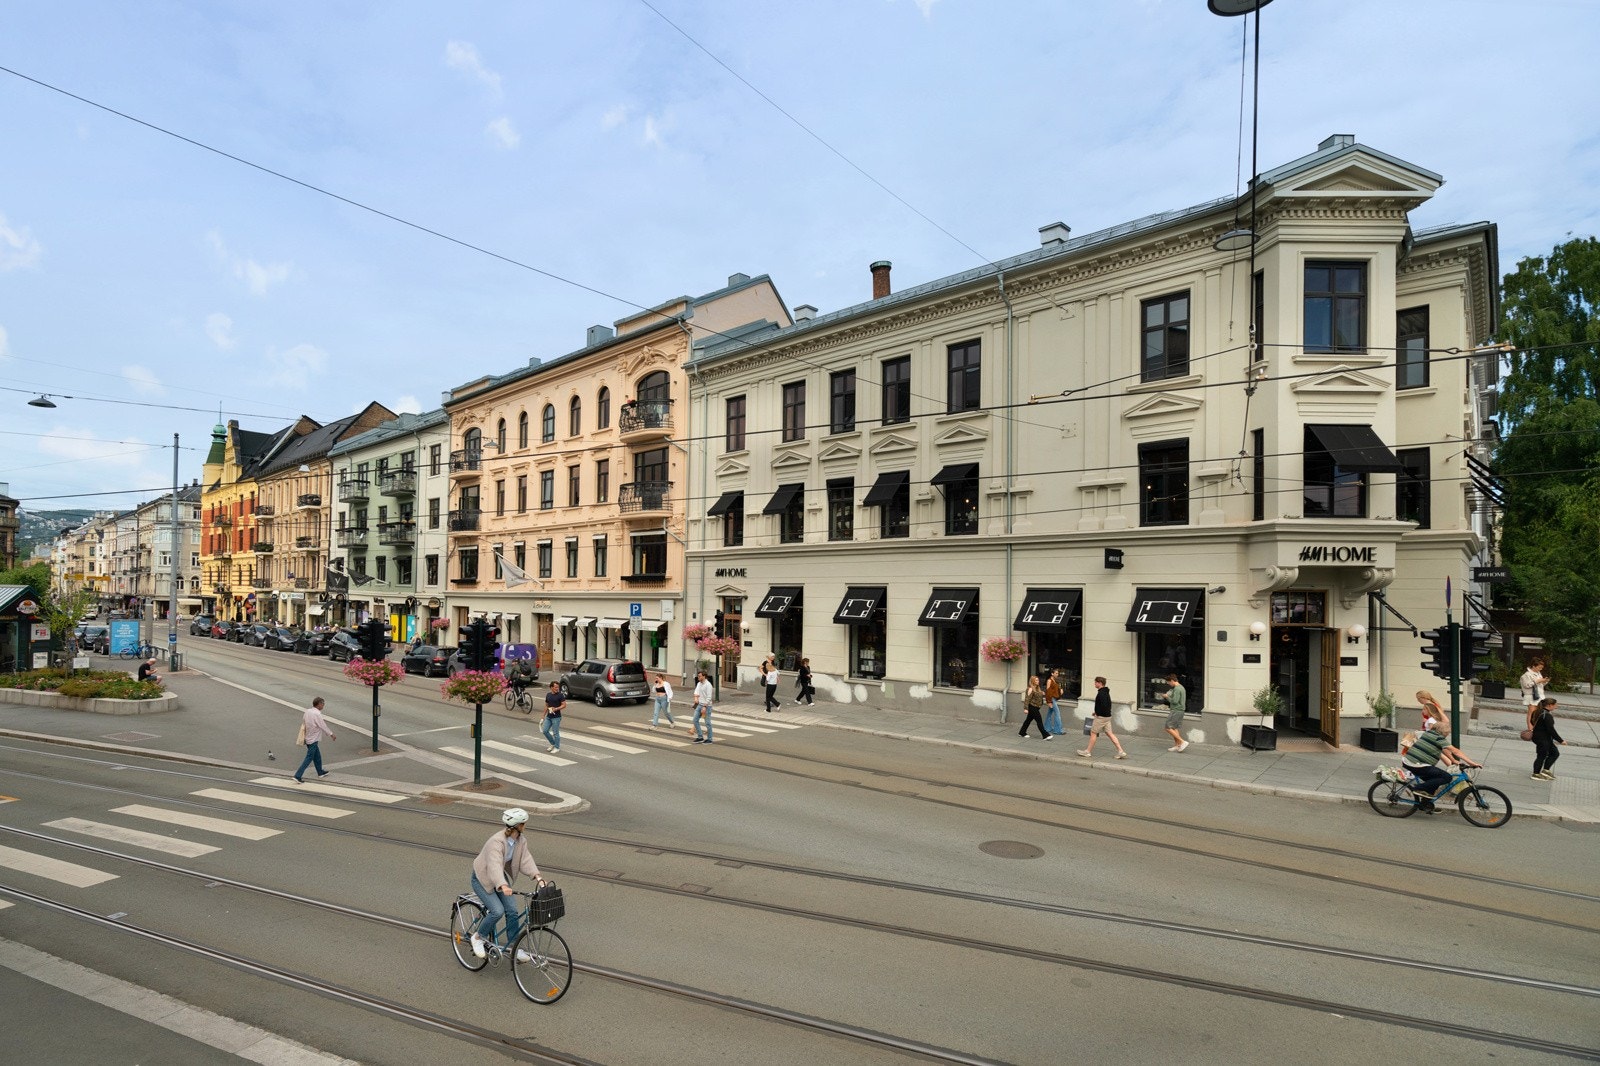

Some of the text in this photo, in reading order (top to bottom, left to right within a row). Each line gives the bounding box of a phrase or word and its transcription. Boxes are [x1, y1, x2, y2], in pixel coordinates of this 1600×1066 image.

[1323, 546, 1377, 562] HOME
[725, 568, 747, 577] HOME
[632, 604, 640, 615] P
